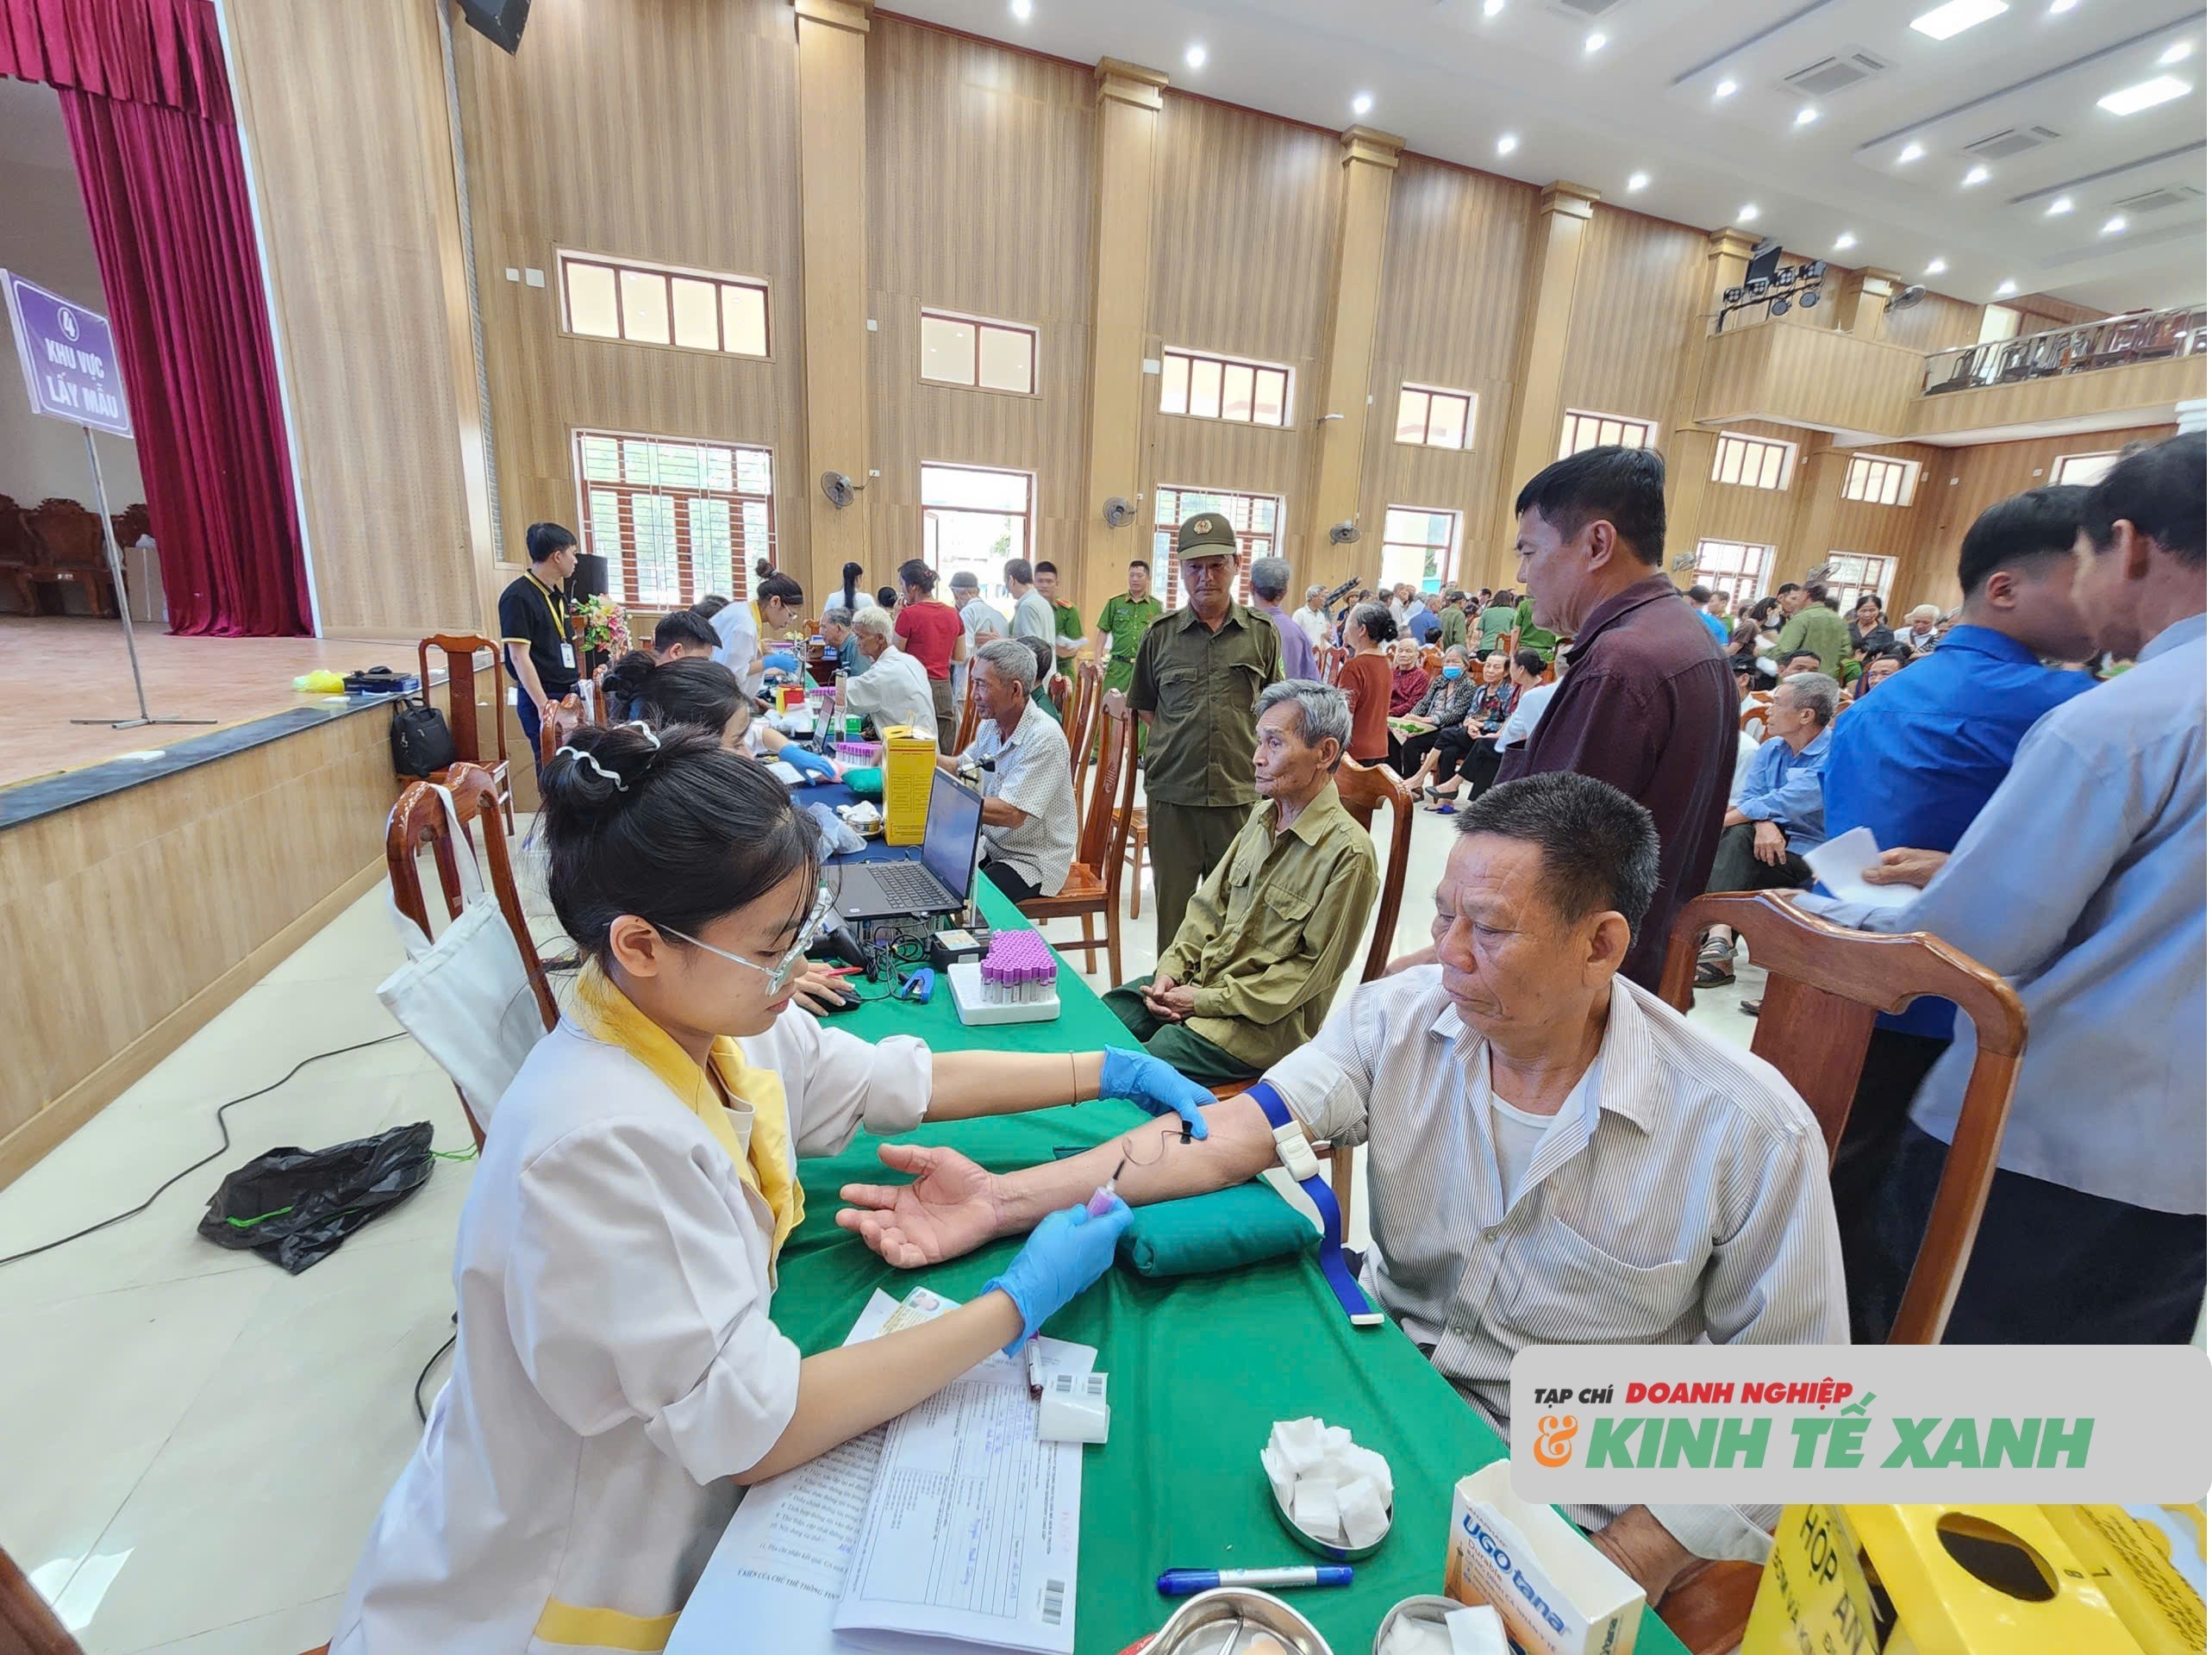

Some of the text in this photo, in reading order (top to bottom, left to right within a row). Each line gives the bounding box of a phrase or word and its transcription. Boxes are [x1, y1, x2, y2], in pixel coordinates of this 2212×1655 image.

[62, 311, 76, 337] 4
[45, 339, 105, 381] KHU VỰC
[47, 372, 118, 418] LẤY MẪU
[1468, 1539, 1503, 1583] Durable
